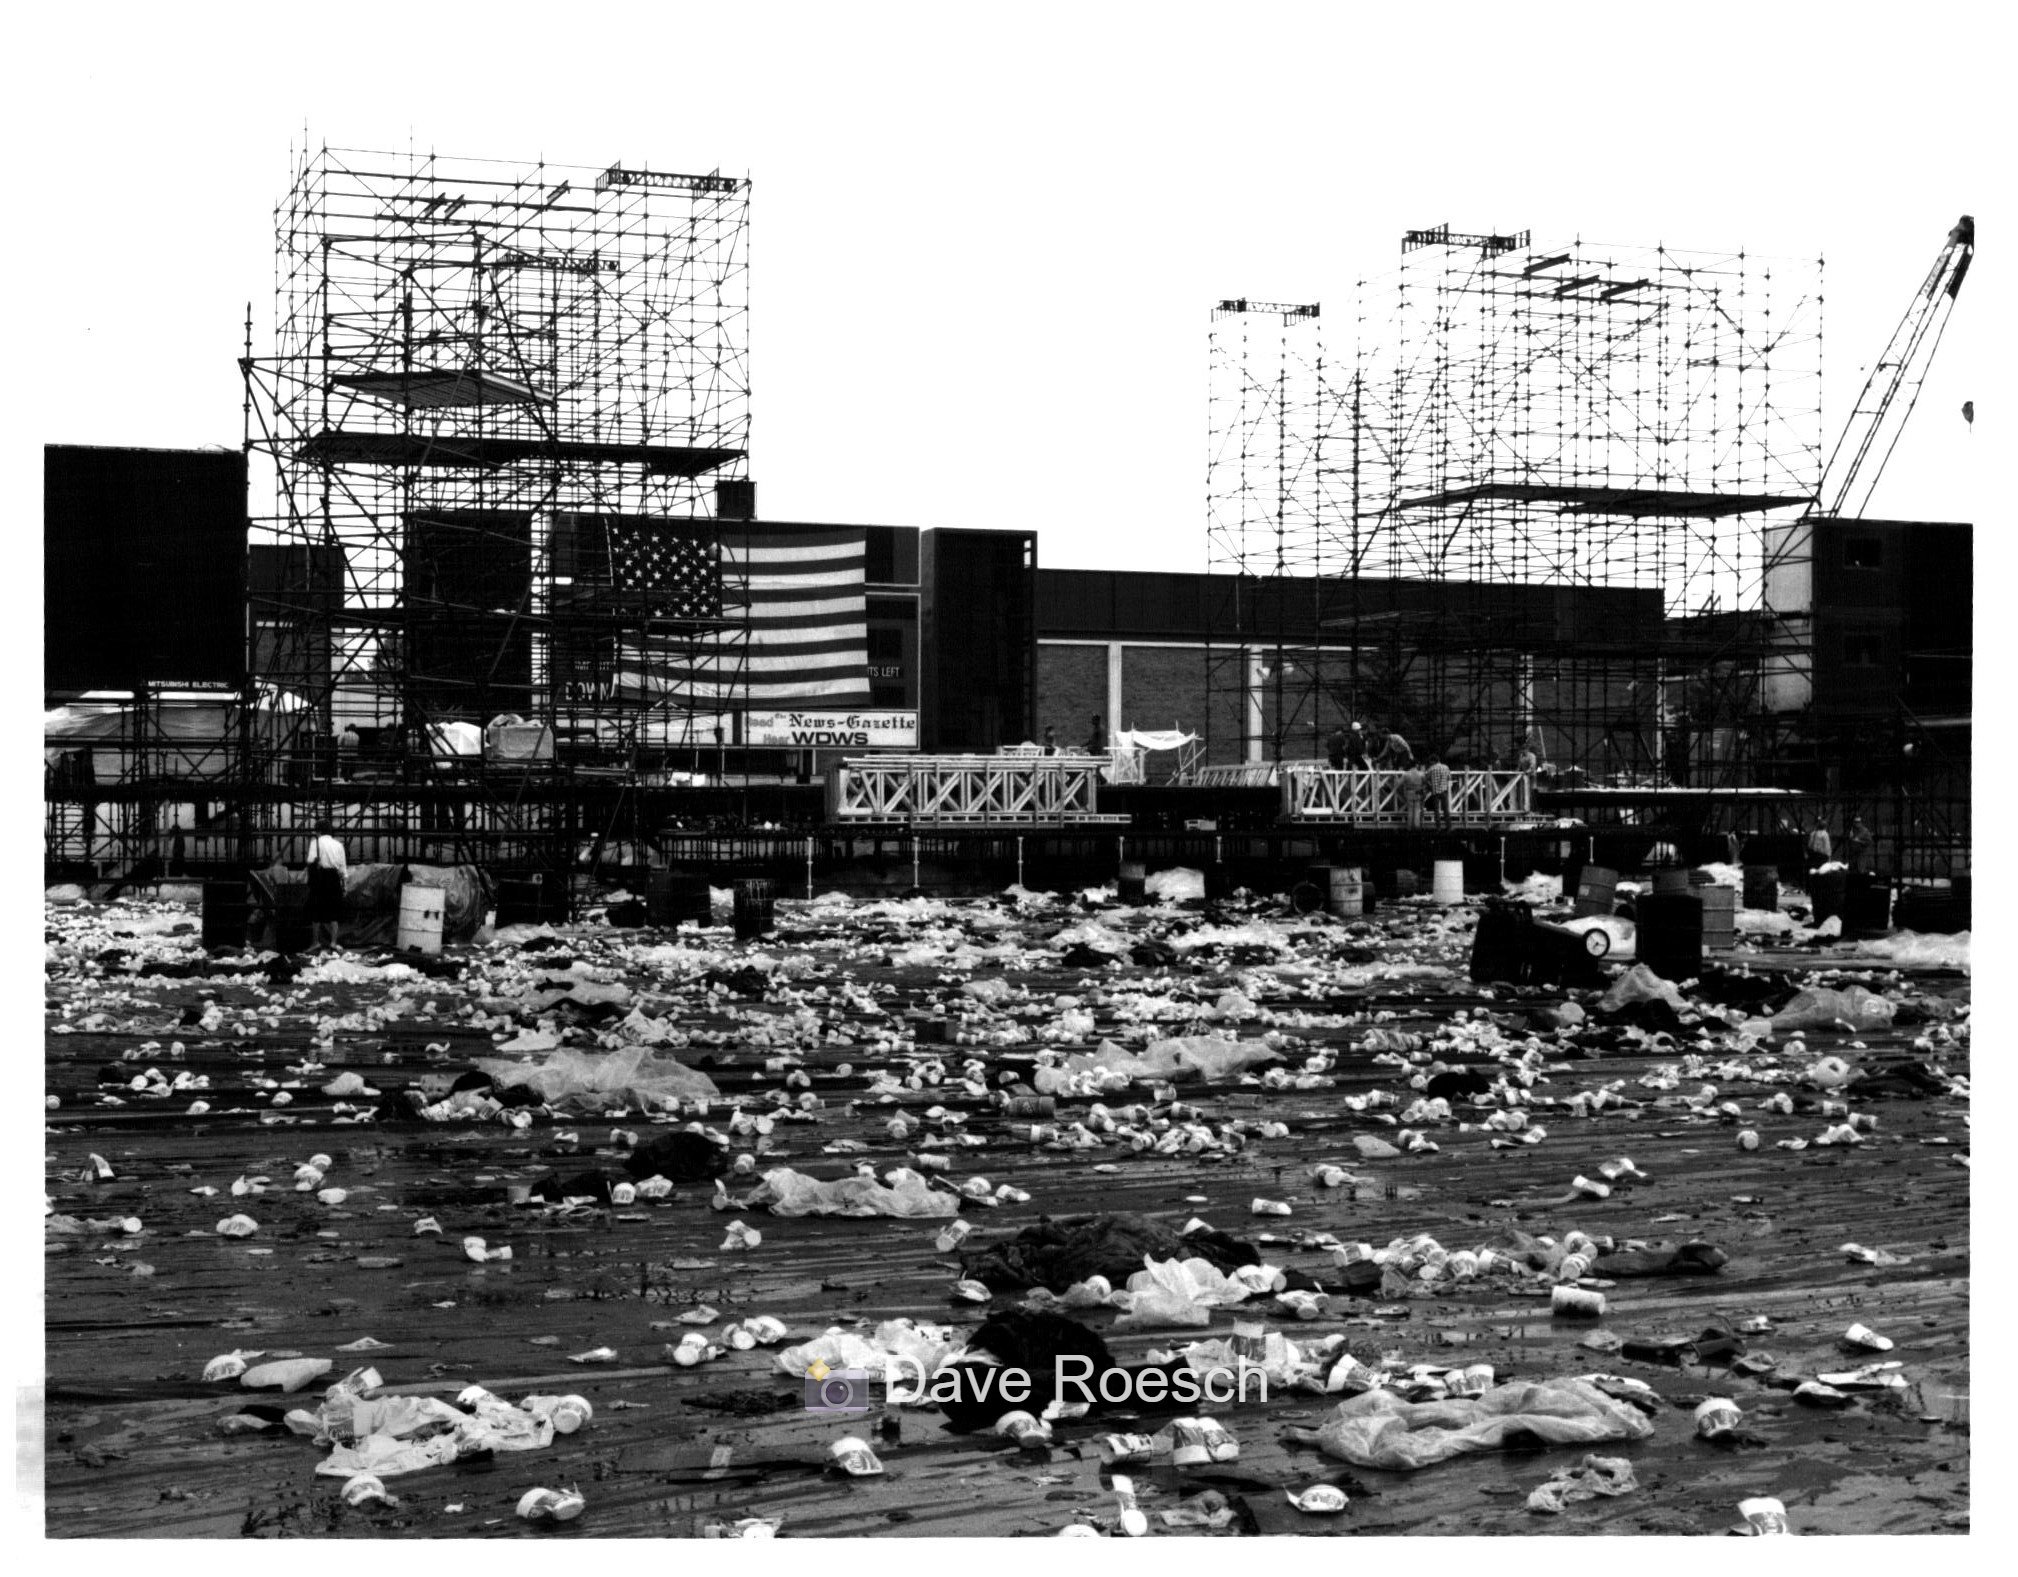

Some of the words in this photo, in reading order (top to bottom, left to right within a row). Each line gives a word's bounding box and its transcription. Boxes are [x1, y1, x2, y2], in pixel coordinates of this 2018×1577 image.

[881, 666, 900, 677] LEFT
[147, 680, 190, 688] MITSUBISHI
[192, 680, 229, 689] ELECTRIC
[789, 713, 915, 730] News-Gazette
[791, 732, 868, 745] WDWS
